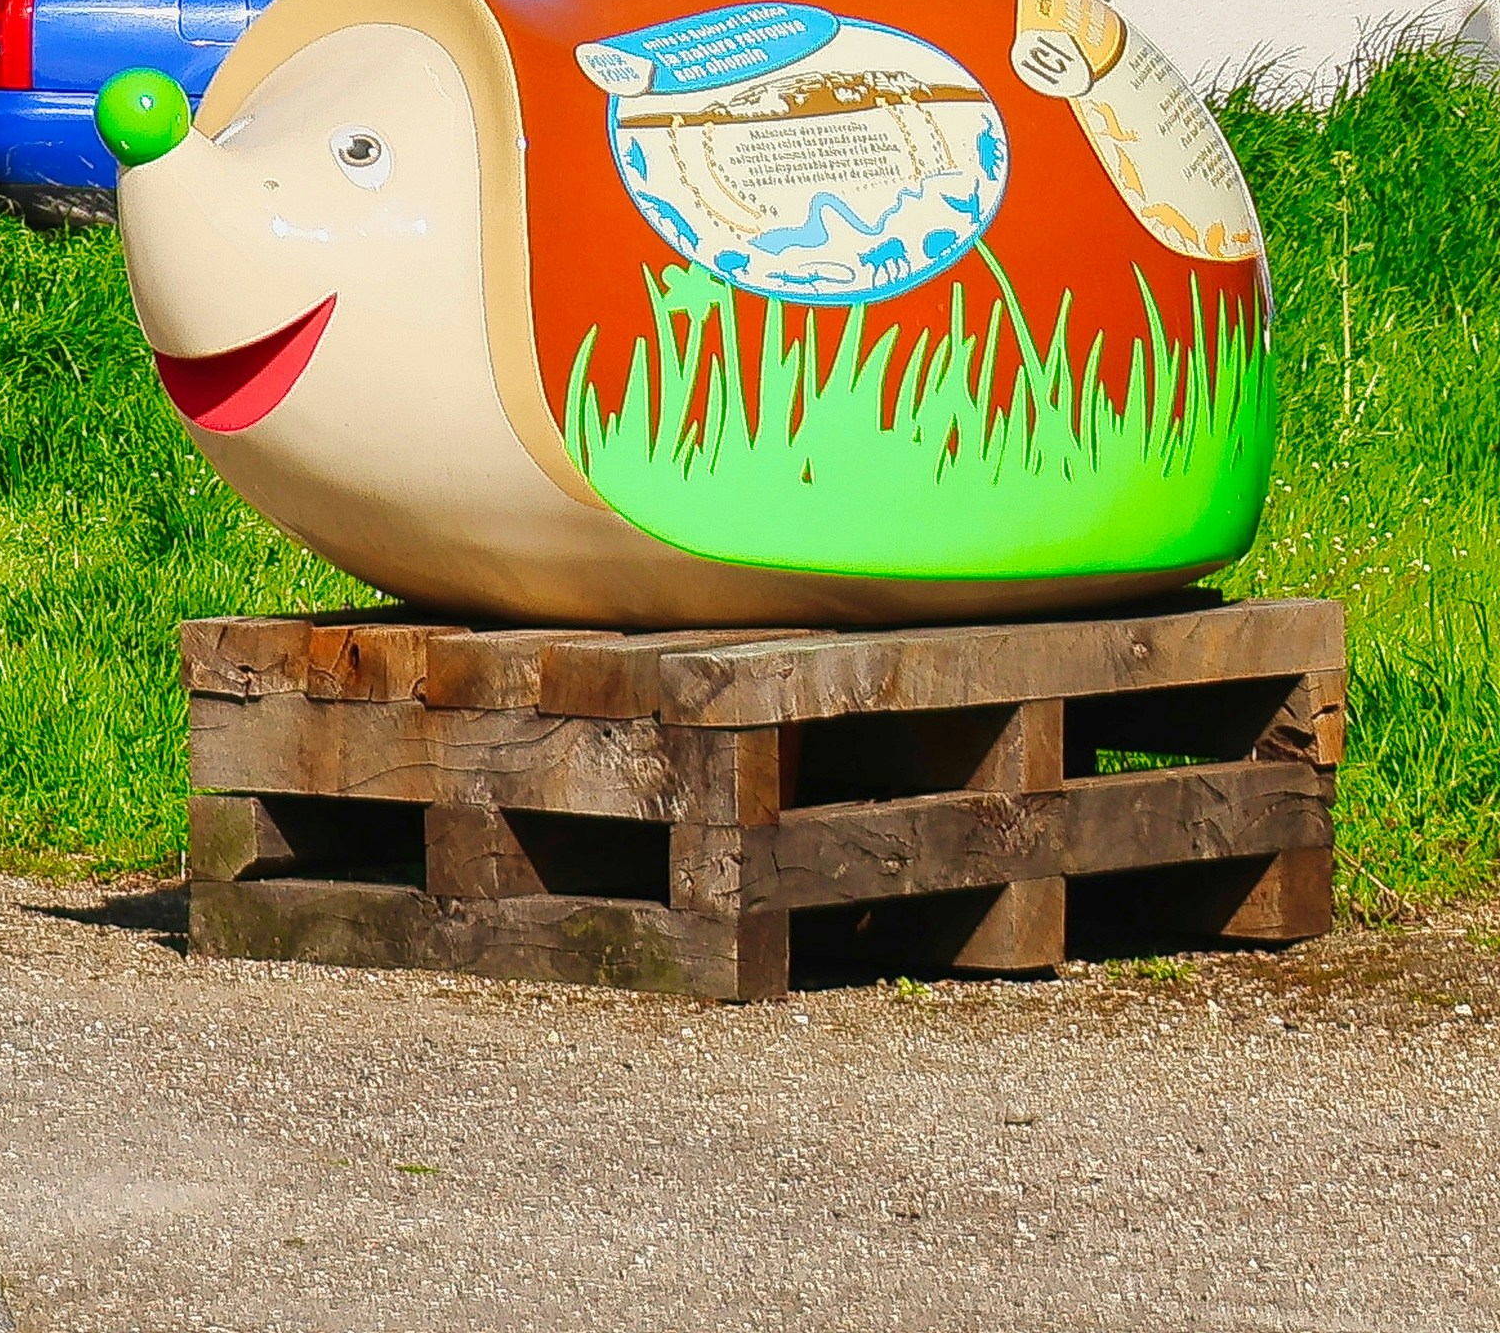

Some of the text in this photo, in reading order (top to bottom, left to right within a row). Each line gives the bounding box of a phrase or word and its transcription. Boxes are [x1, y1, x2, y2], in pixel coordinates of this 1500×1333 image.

[655, 19, 807, 67] la nature retrouve
[673, 48, 768, 83] son chemin
[1020, 36, 1075, 85] ICI
